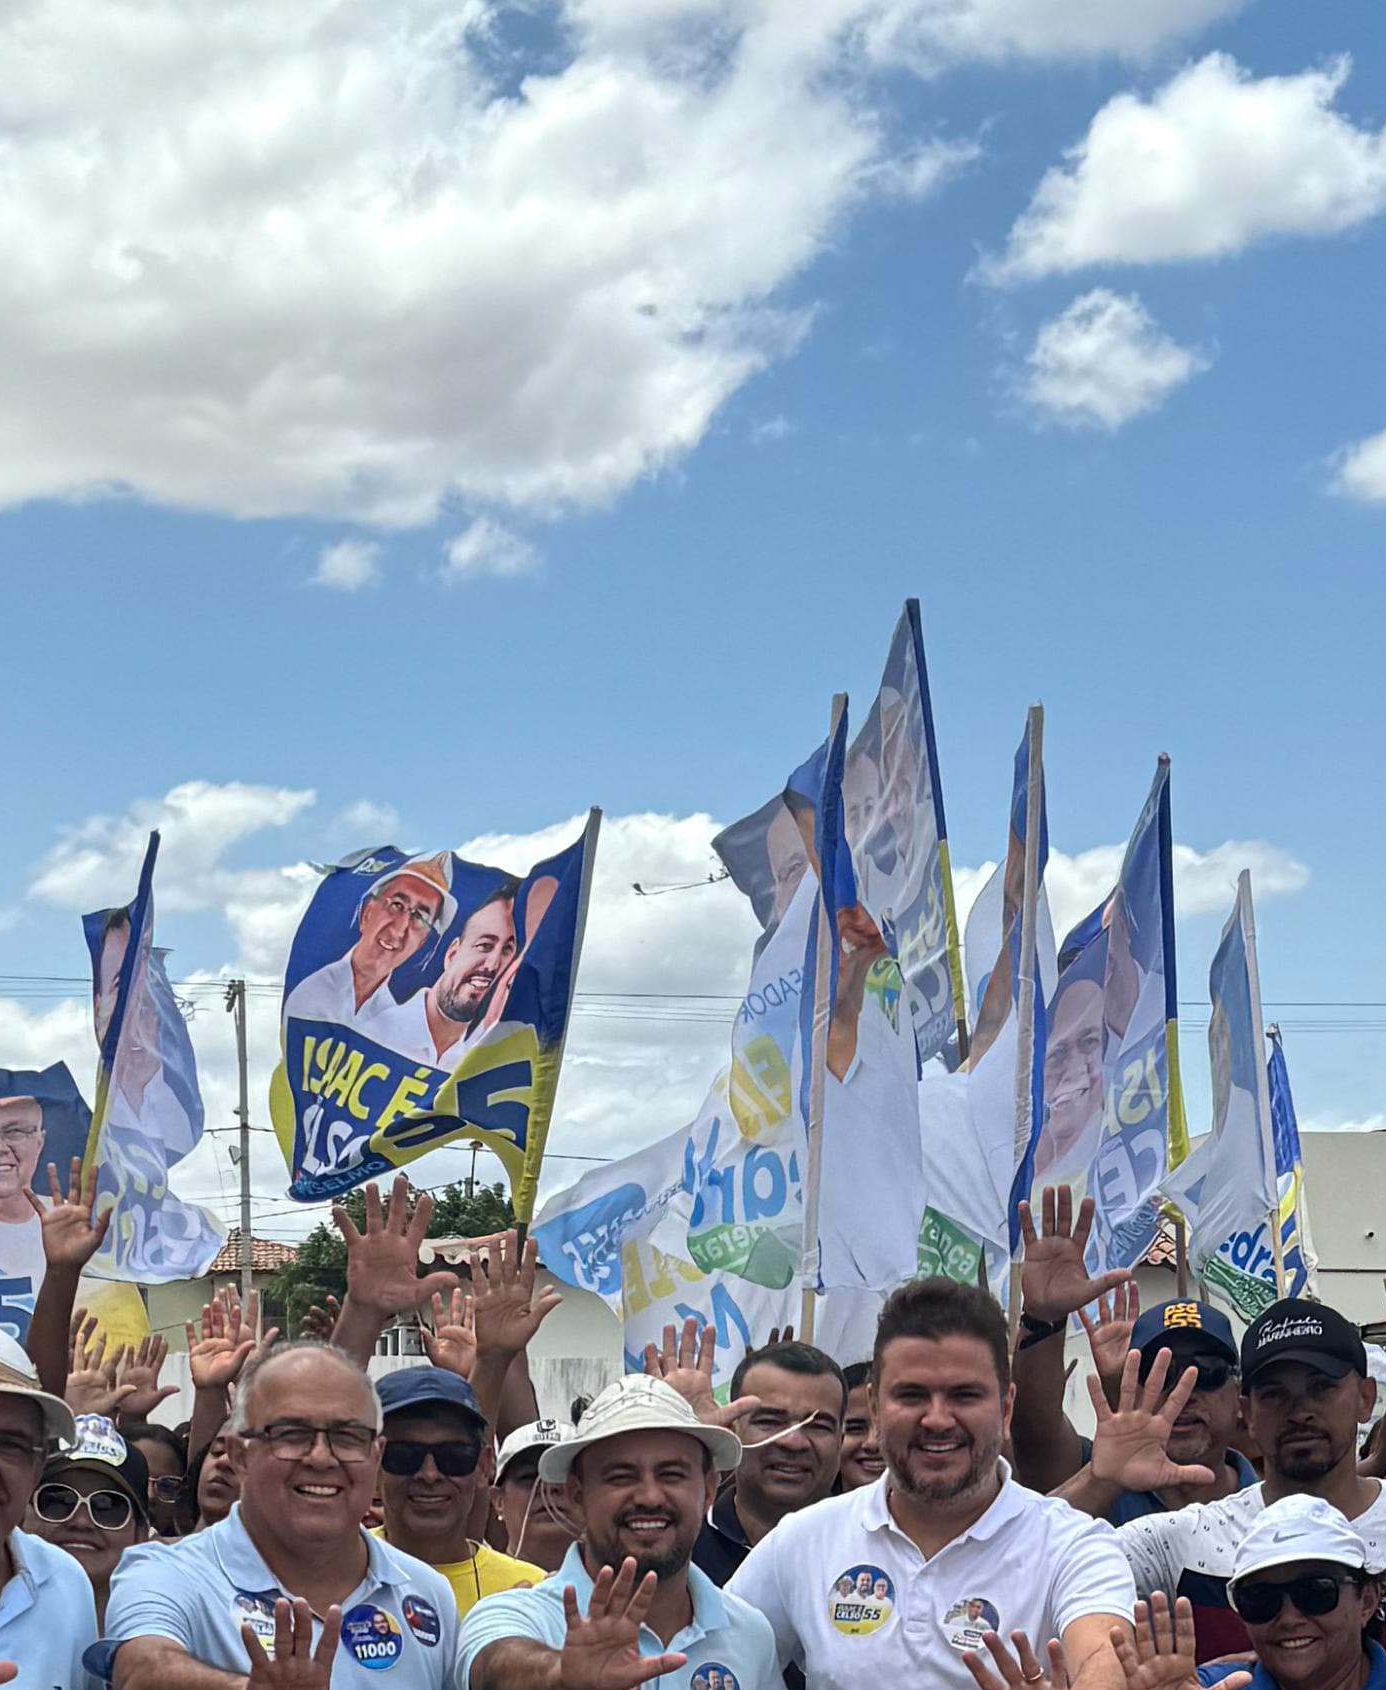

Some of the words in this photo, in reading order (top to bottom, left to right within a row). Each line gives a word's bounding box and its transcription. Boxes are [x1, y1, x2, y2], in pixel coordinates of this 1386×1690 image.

[1164, 1302, 1198, 1321] psd
[862, 1608, 882, 1621] 55
[355, 1640, 397, 1660] 11000
